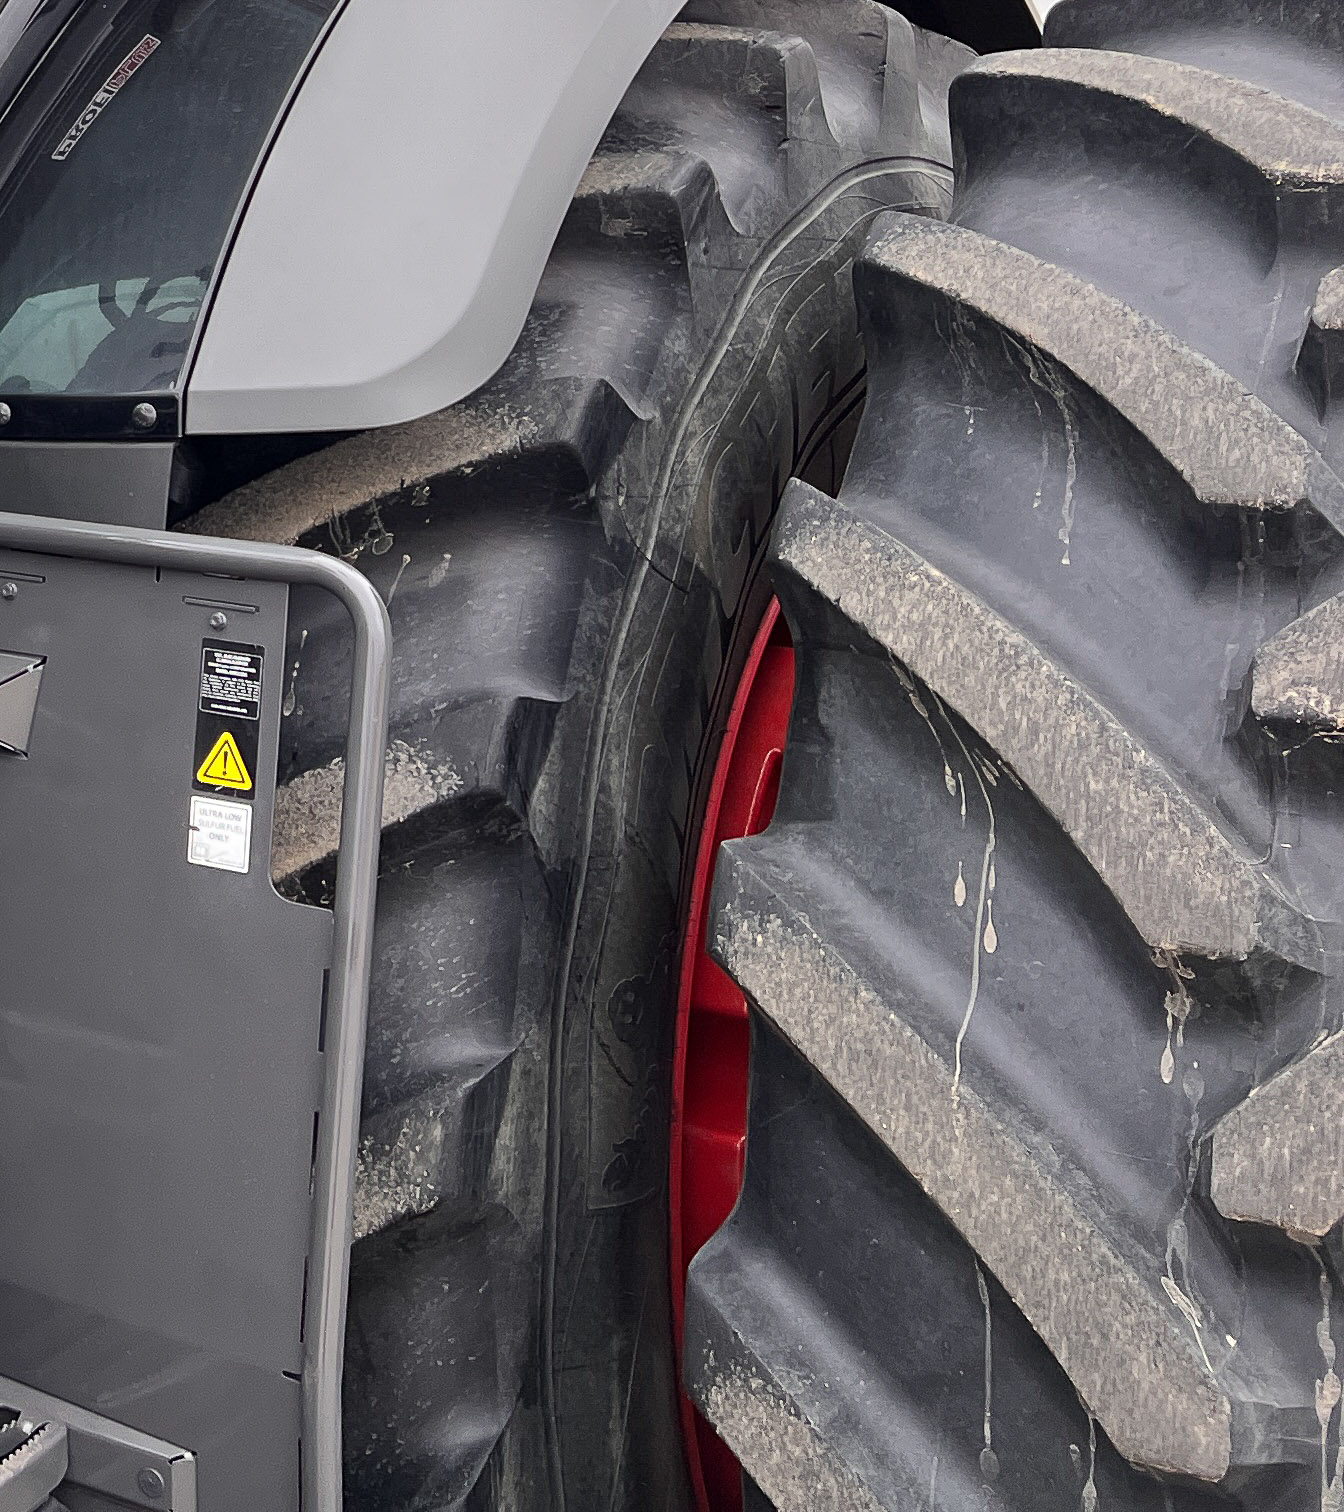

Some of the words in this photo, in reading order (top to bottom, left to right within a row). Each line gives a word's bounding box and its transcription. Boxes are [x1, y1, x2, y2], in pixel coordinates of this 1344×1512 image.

[199, 807, 223, 819] ULTRA
[225, 812, 243, 822] LOW
[208, 832, 230, 843] ONLY
